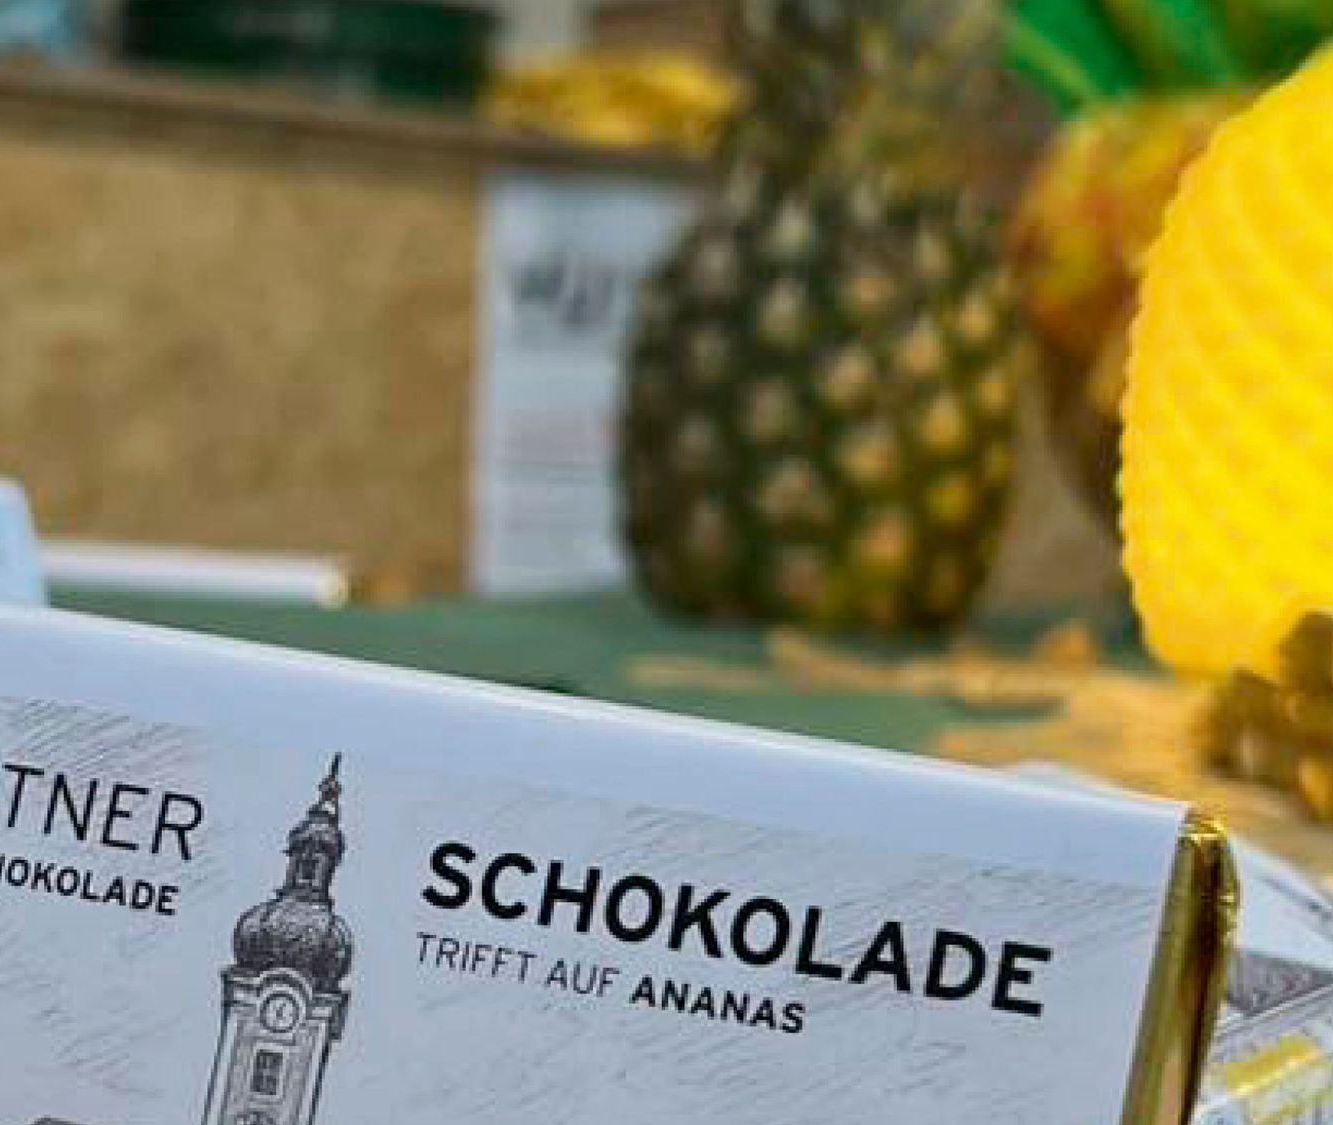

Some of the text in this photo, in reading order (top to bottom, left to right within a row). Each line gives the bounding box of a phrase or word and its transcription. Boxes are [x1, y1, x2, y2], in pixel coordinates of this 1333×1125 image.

[414, 931, 807, 1036] TRIFFT AUF ANANAS
[420, 840, 1055, 1019] SCHOKOLADE
